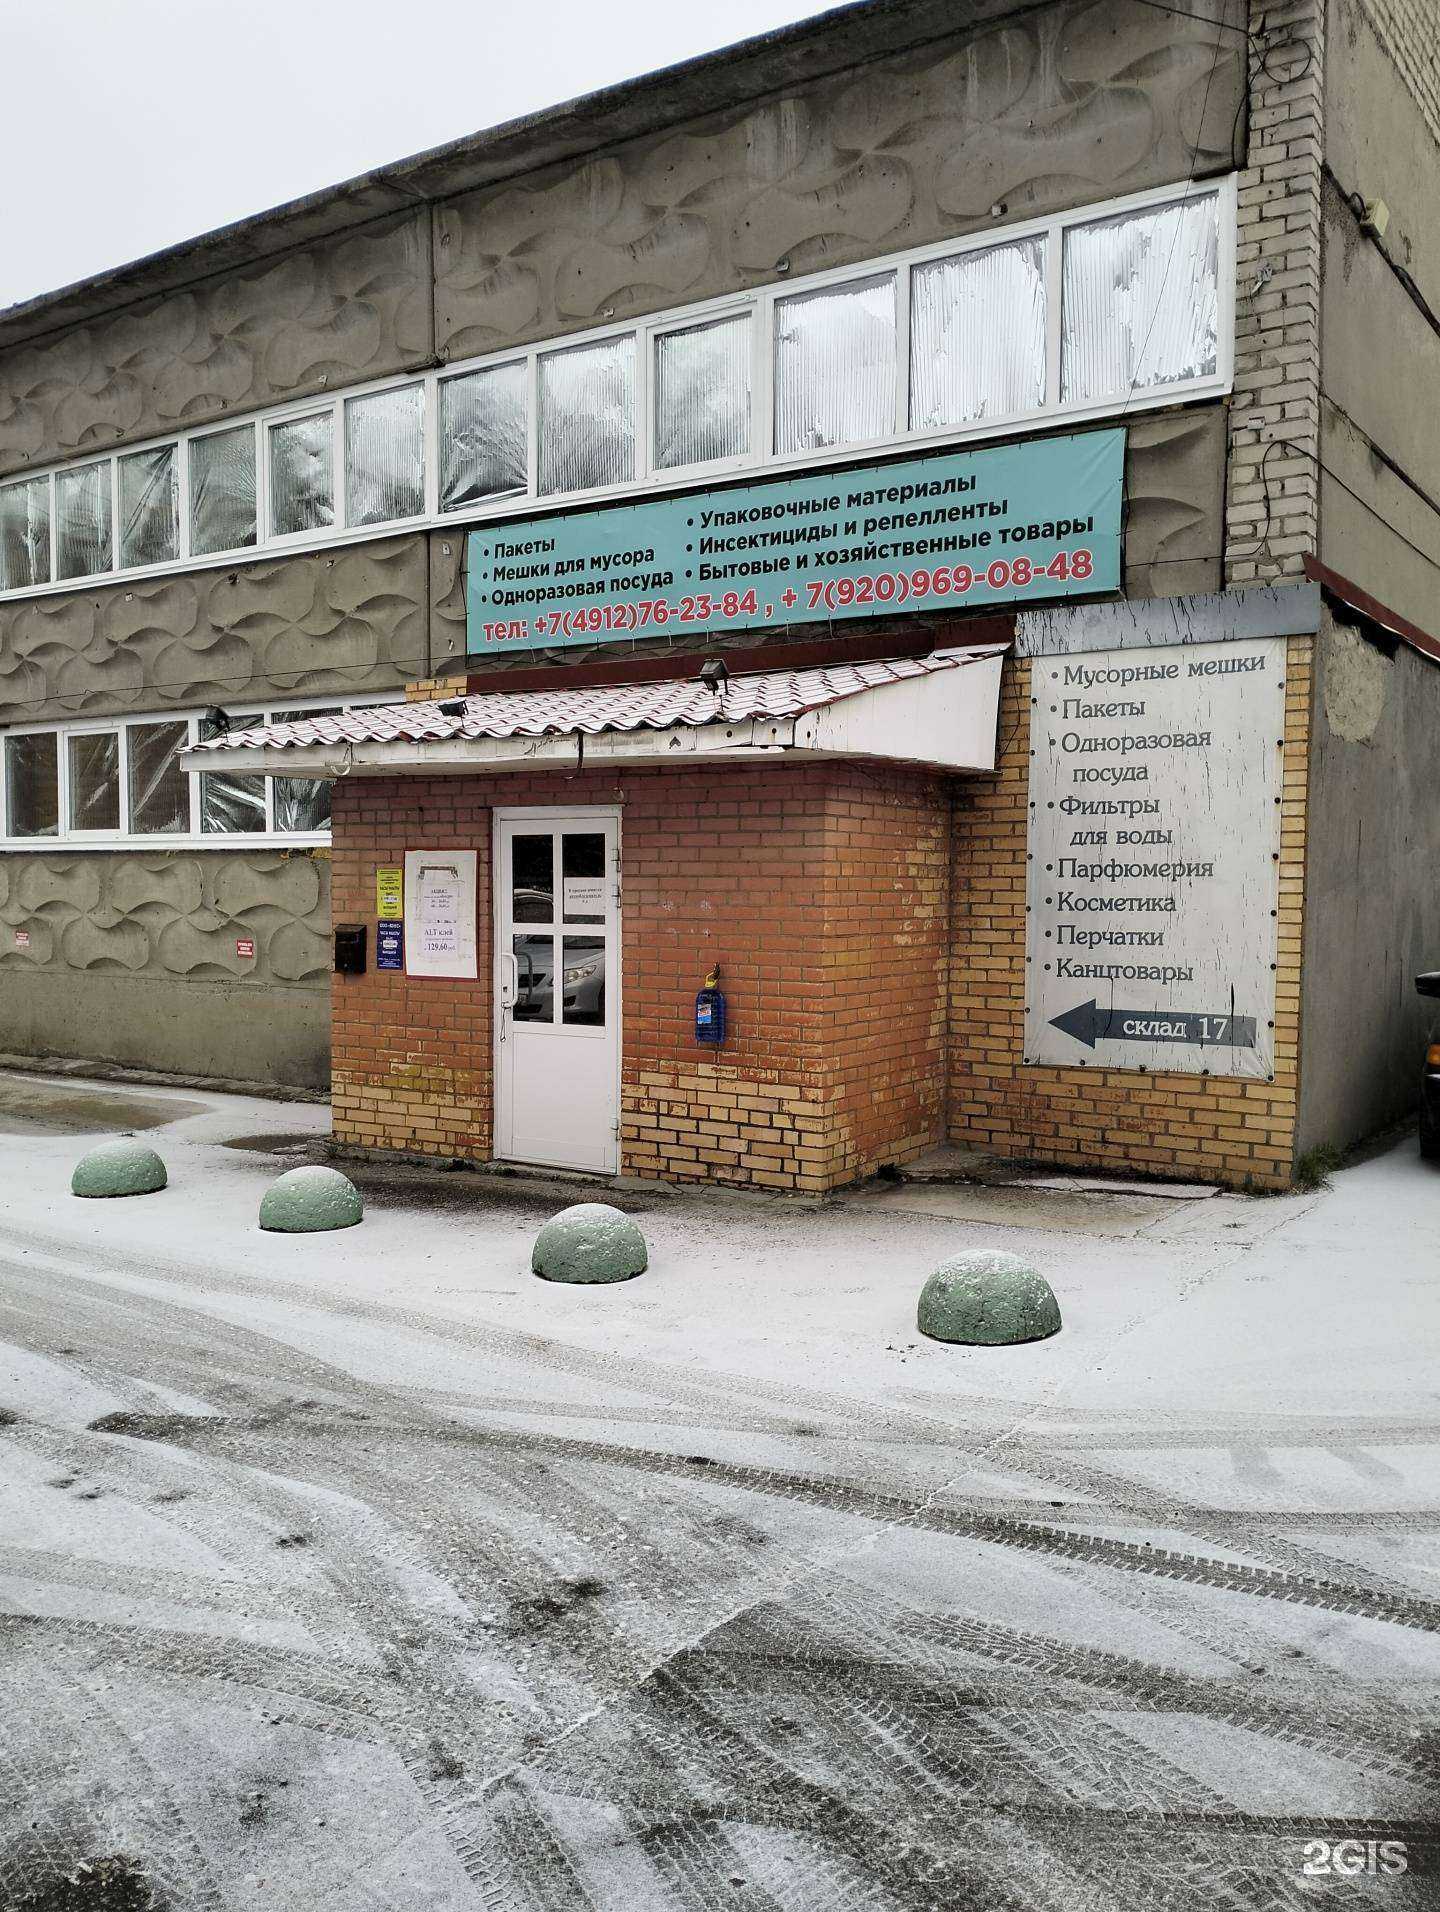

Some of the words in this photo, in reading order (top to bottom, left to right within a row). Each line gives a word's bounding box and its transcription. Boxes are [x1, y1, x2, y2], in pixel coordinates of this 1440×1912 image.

[700, 497, 840, 528] Упаковочные
[847, 475, 976, 508] материалы
[699, 522, 837, 554] Инсектициды
[844, 521, 856, 536] и
[864, 499, 1008, 538] репелленты
[494, 538, 555, 558] Пакеты
[699, 555, 790, 581] Бытовые
[796, 553, 809, 569] и
[814, 529, 991, 567] хозяйственные
[999, 516, 1093, 544] товары
[493, 564, 550, 583] Мешки
[554, 557, 585, 576] для
[590, 548, 655, 572] мусора
[492, 579, 606, 606] Одноразовая
[610, 570, 674, 596] посуда
[482, 620, 529, 641] тел:
[1063, 664, 1179, 689] Мусорные
[1187, 655, 1266, 677] мешки
[1062, 699, 1146, 719] Пакеты
[1061, 731, 1212, 754] Одноразовая
[1072, 765, 1149, 786] посуда
[1059, 795, 1160, 818] Фильтры
[1070, 830, 1107, 846] для
[1116, 828, 1173, 845] воды
[1058, 858, 1213, 882] Парфюмерия
[1057, 892, 1177, 912] Косметика
[1056, 925, 1164, 949] Перчатки
[1056, 958, 1194, 984] Канцтовары
[1123, 1019, 1186, 1038] склад
[1199, 1017, 1228, 1040] 17
